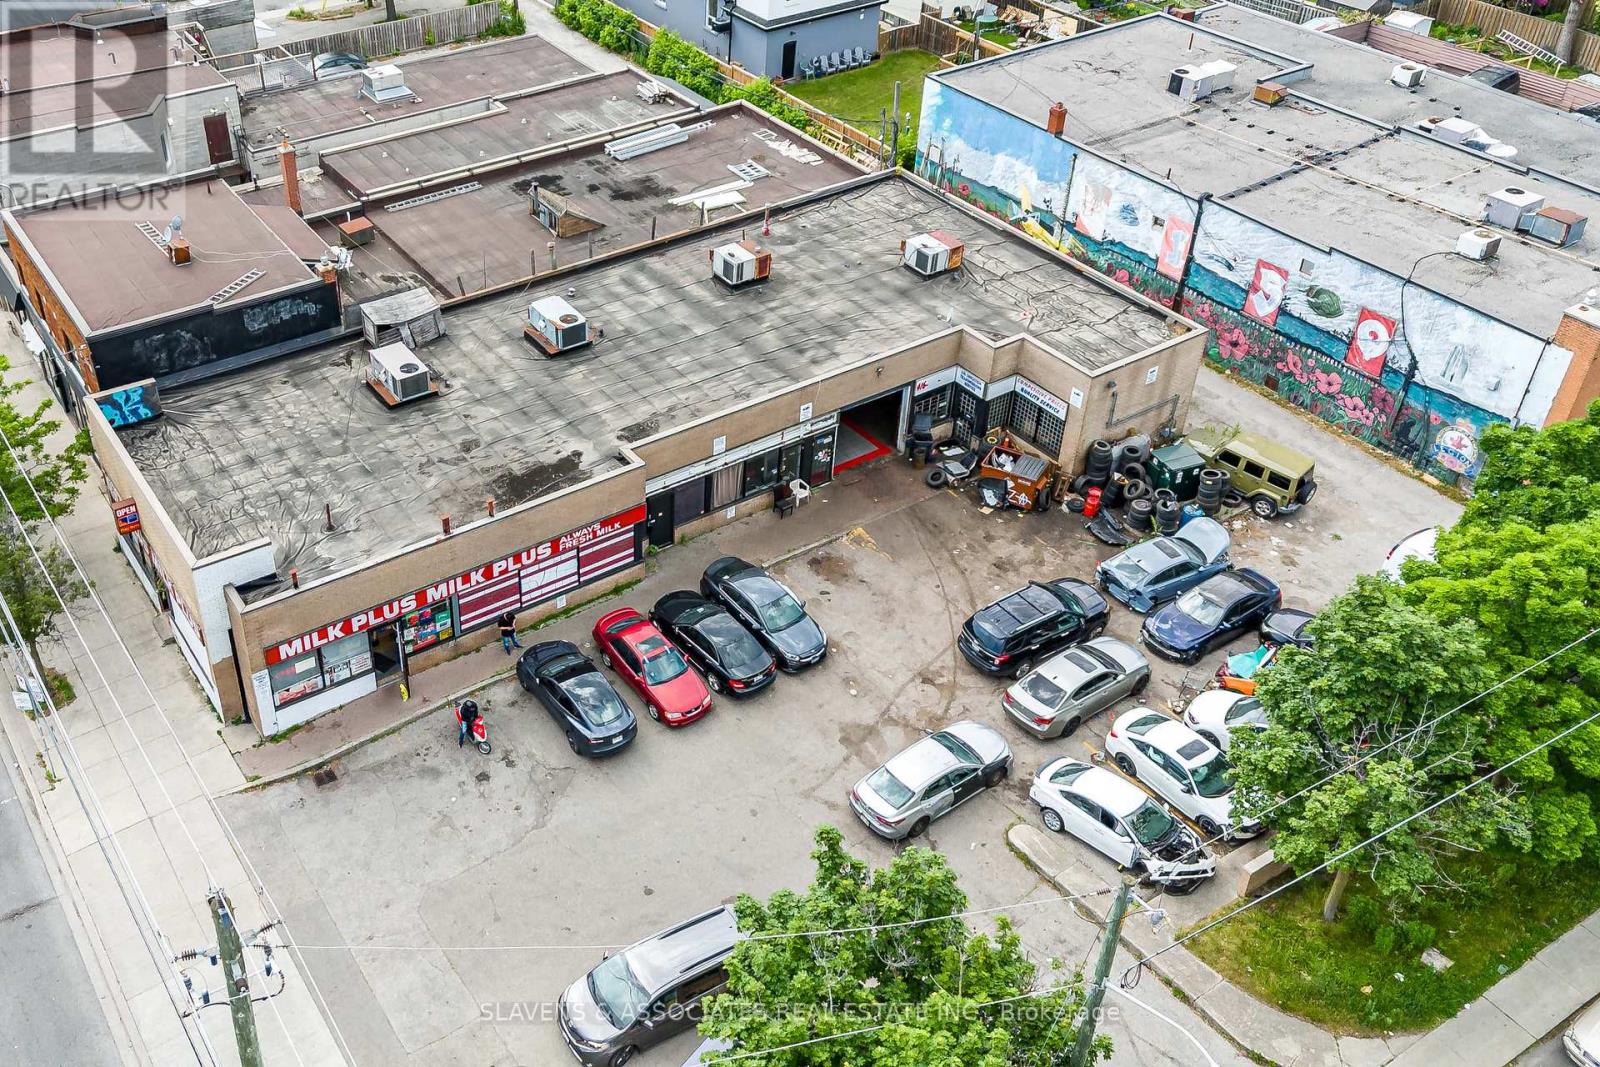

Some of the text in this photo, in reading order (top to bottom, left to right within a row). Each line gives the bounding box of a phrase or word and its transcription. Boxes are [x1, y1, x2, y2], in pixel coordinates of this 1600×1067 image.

[116, 504, 137, 517] OPEN
[559, 522, 601, 544] ALWAYS
[559, 521, 622, 552] FRESH MILK
[279, 622, 345, 660] MILK
[351, 593, 417, 633] PLUS
[426, 568, 486, 603] MILK
[493, 543, 552, 577] PLUS
